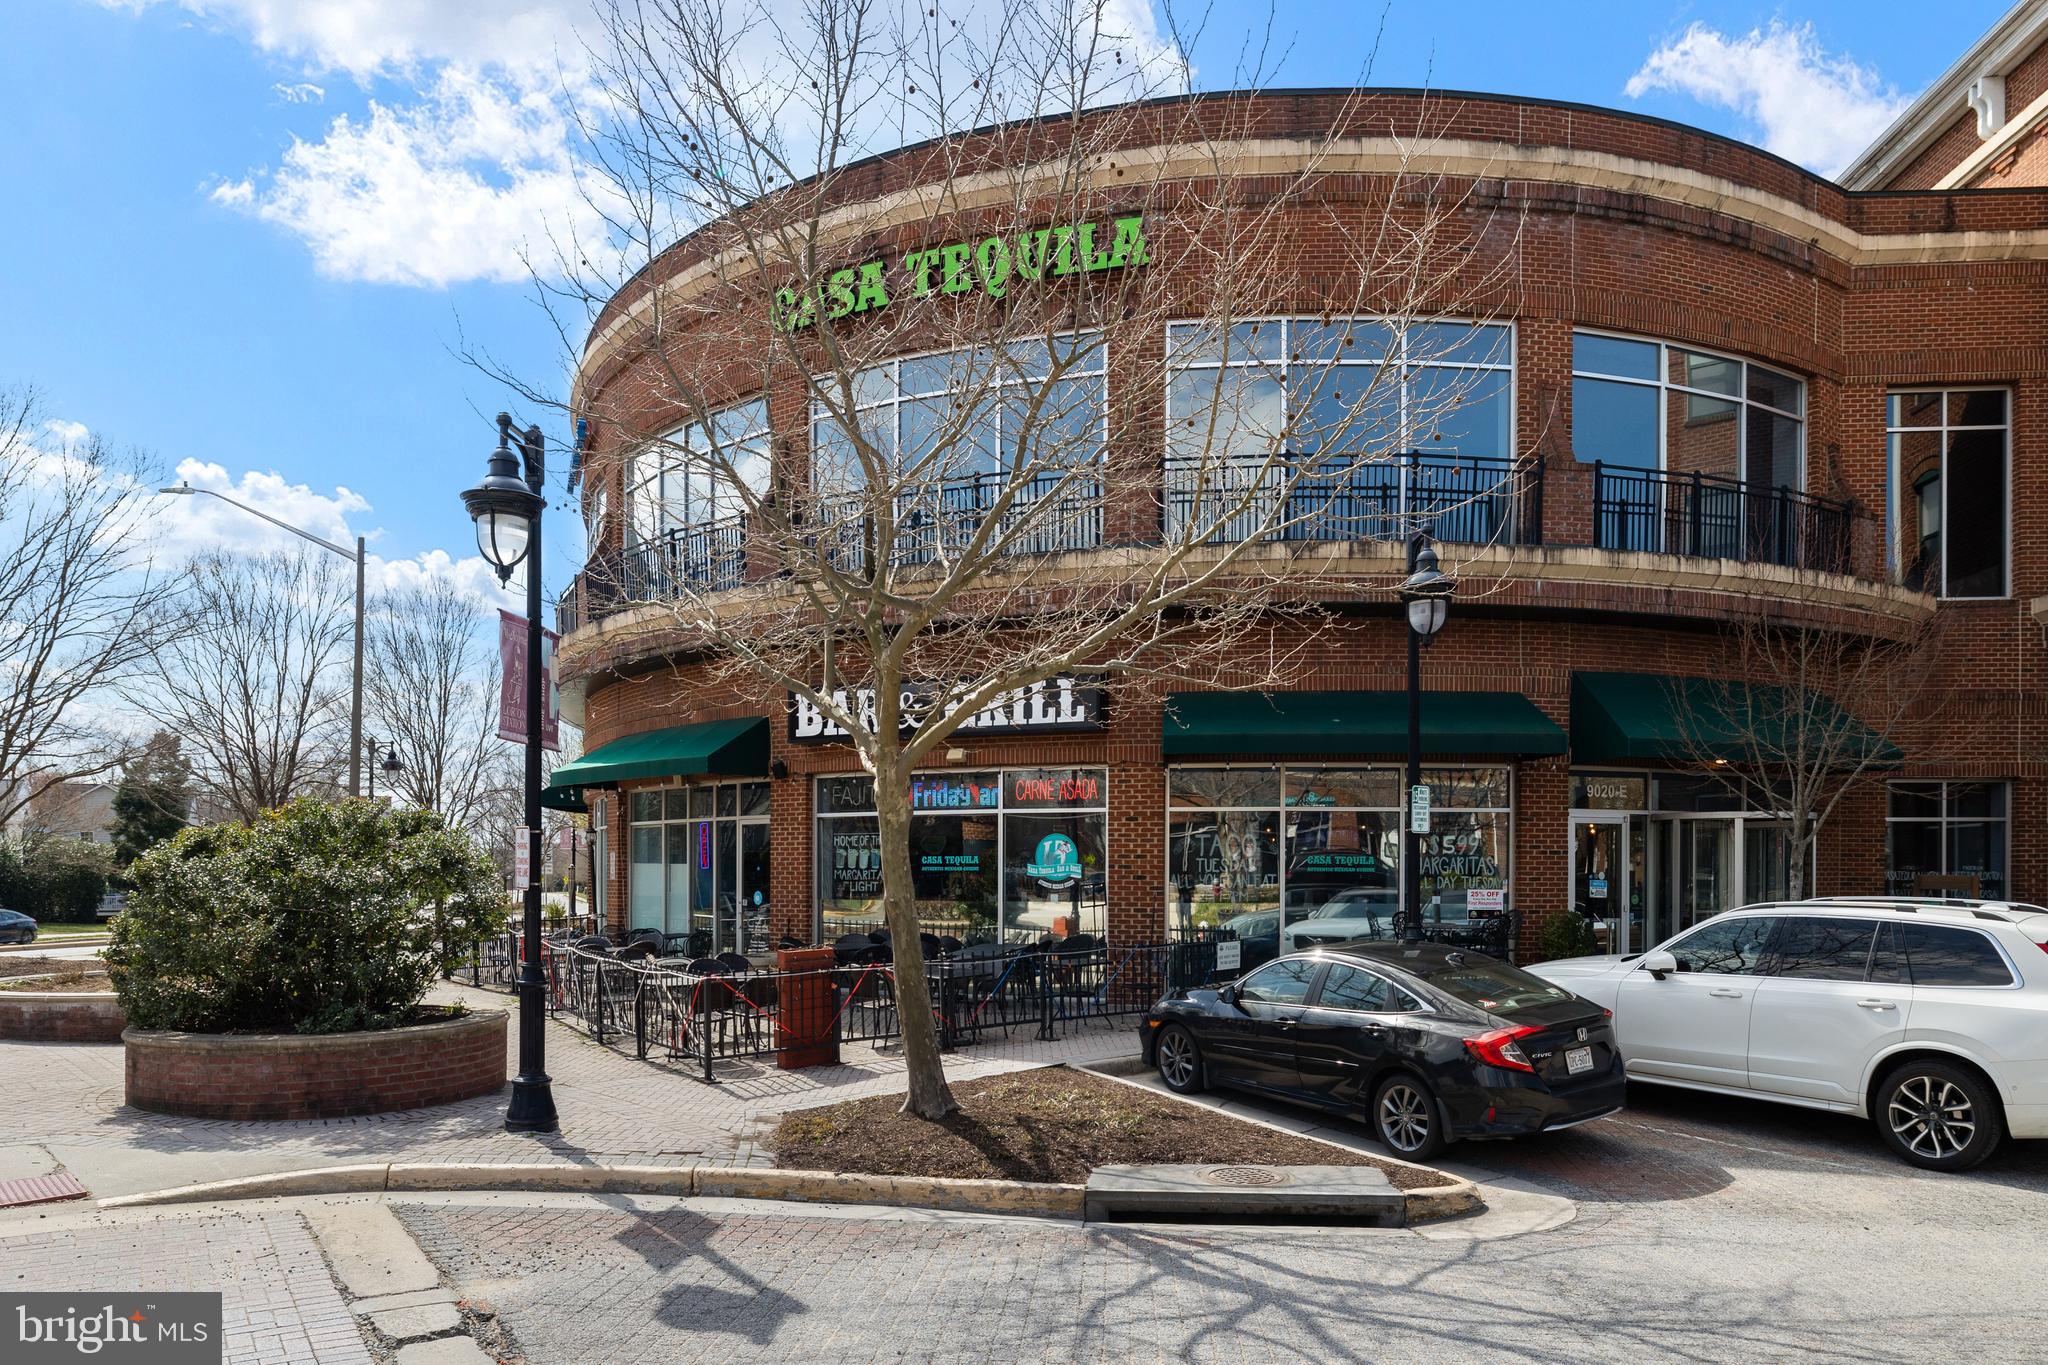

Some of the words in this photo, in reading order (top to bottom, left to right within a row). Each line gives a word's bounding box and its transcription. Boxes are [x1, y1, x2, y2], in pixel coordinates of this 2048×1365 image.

[770, 261, 890, 332] CASA
[906, 217, 1151, 299] TEQUILA
[795, 688, 880, 737] BAR
[944, 678, 1086, 729] GRILL
[832, 785, 876, 806] FAJIT
[913, 781, 971, 807] Friday
[1015, 778, 1054, 801] CARNE
[1059, 778, 1098, 800] ASADA
[1586, 784, 1628, 798] 9020-E
[834, 836, 859, 847] HOME
[861, 835, 869, 847] OF
[872, 835, 882, 846] TH
[1195, 833, 1257, 857] TACO
[922, 856, 943, 864] CASA
[944, 855, 979, 866] TEQUILA
[1307, 855, 1332, 865] CASA
[1334, 856, 1374, 867] TEQUILA
[1253, 873, 1277, 889] EAT
[1437, 876, 1457, 889] DAY
[1460, 876, 1503, 889] TUESDAY
[1532, 1051, 1552, 1059] CIVIC
